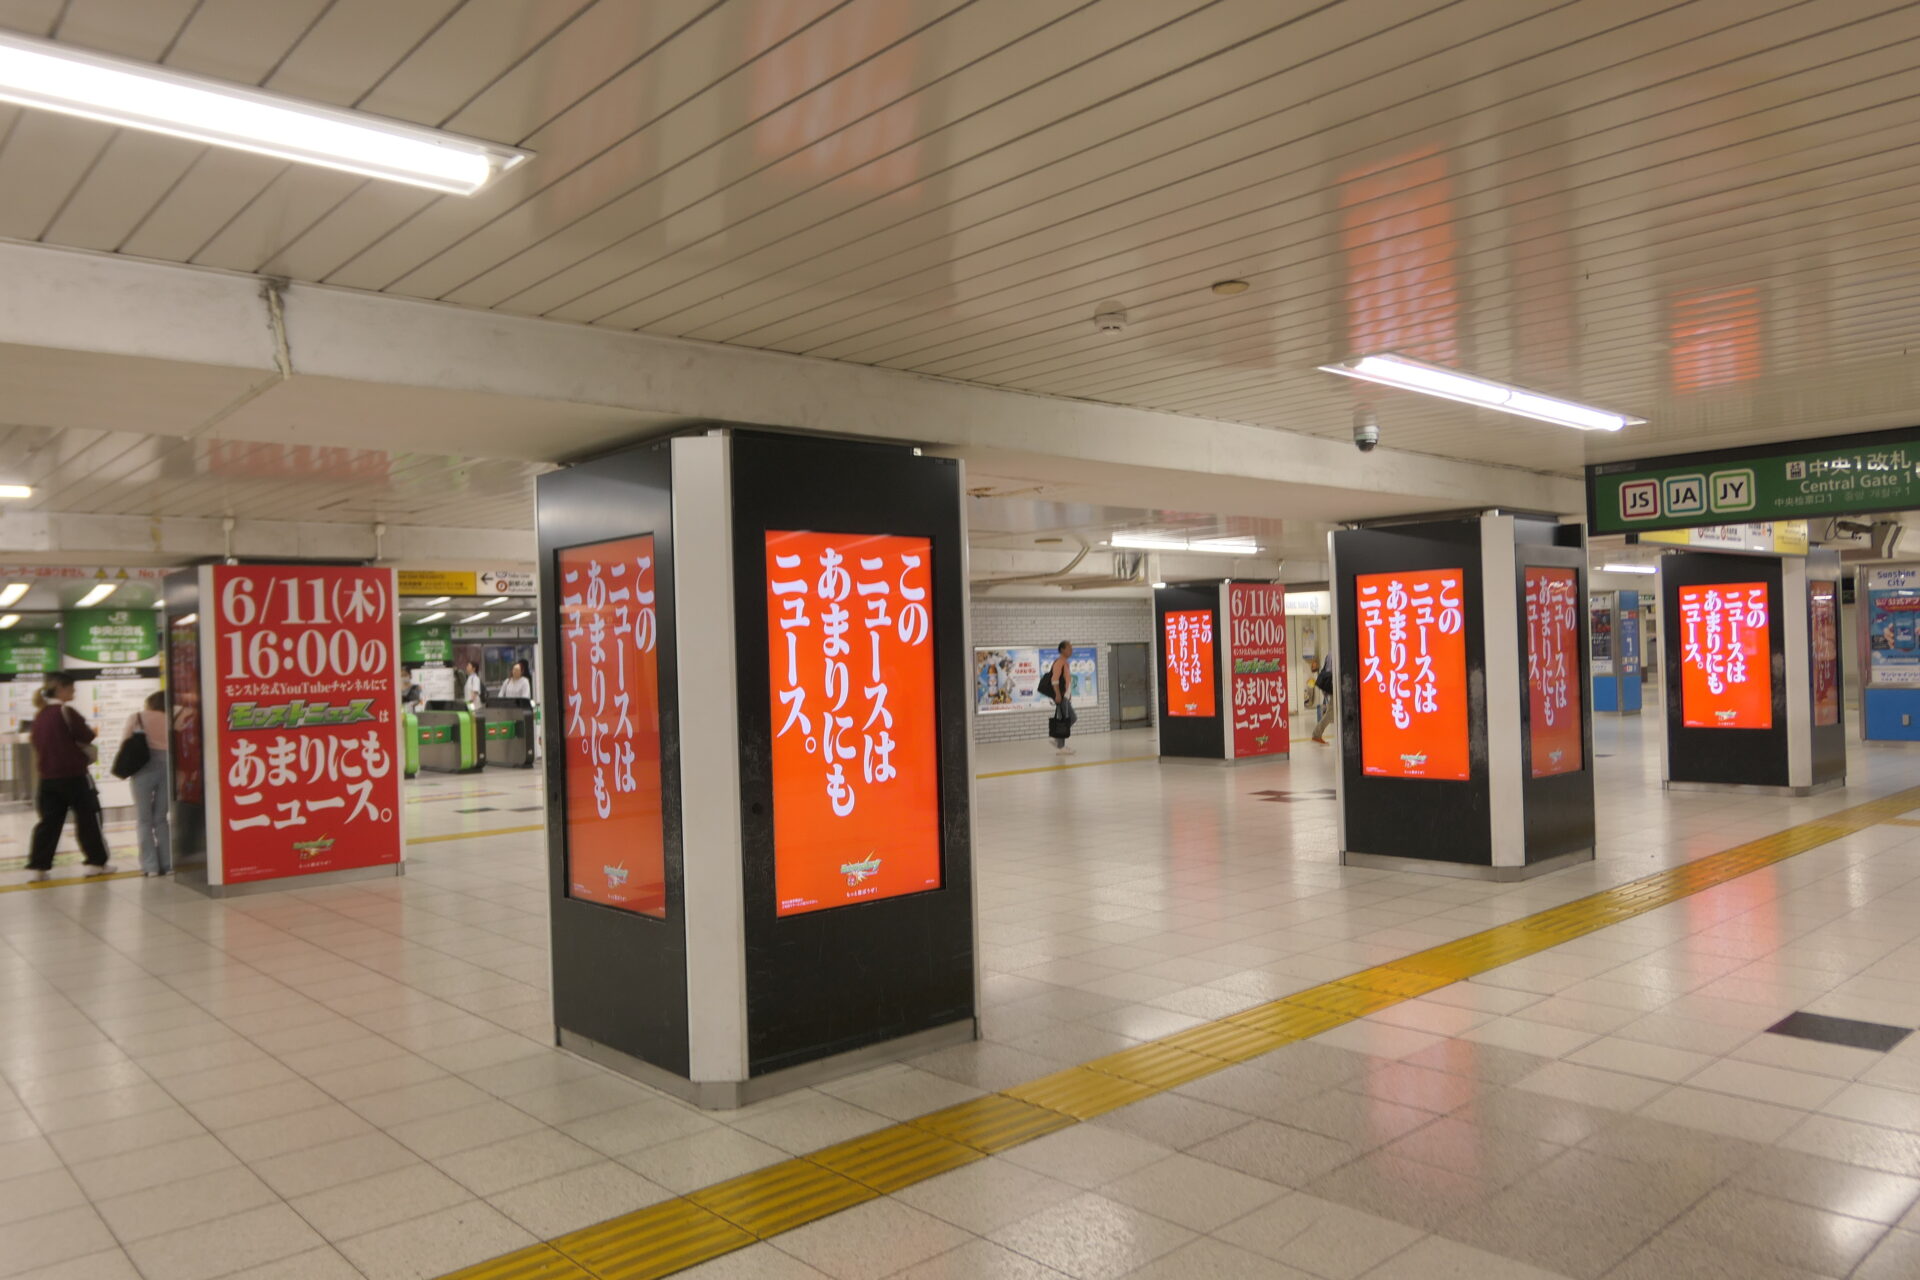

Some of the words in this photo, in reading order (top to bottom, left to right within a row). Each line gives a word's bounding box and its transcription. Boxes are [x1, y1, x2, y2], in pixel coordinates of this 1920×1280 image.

[1630, 491, 1650, 508] JS
[1672, 488, 1697, 505] JA
[1720, 482, 1744, 500] JY
[1800, 475, 1854, 494] Central
[1860, 474, 1898, 488] Gate
[1904, 471, 1910, 484] 1
[1810, 450, 1911, 477] 中央1改札
[636, 556, 657, 652] この
[898, 554, 928, 646] この
[1438, 579, 1462, 634] この
[1565, 579, 1576, 632] この
[1746, 590, 1766, 628] この
[1878, 569, 1916, 578] Sunshine
[108, 611, 129, 624] JR
[1166, 618, 1178, 674] ニュース。
[1190, 617, 1201, 684] ニュースは
[1202, 615, 1212, 642] この
[1232, 618, 1284, 646] 16:00の
[1360, 586, 1386, 693] ニュース。
[1411, 583, 1438, 713] ニュースは
[1539, 576, 1554, 726] あまりにも
[1550, 582, 1567, 709] ニュースは
[1682, 594, 1704, 670] ニュース。
[1704, 590, 1724, 694] あまりにも
[1724, 593, 1746, 682] ニュースは
[224, 629, 387, 680] 16:00の
[564, 570, 589, 755] ニュース。
[609, 563, 636, 792] ニュースは
[772, 554, 816, 754] ニュース。
[818, 548, 856, 816] あまりにも
[857, 557, 896, 784] ニュースは
[1178, 615, 1189, 692] あまりにも
[1386, 580, 1410, 729] あまりにも
[586, 560, 611, 820] あまりにも
[1235, 676, 1286, 706] あまりにも
[1236, 706, 1288, 730] ニュース。
[228, 731, 390, 789] あまりにも
[229, 779, 392, 832] ニュース。
